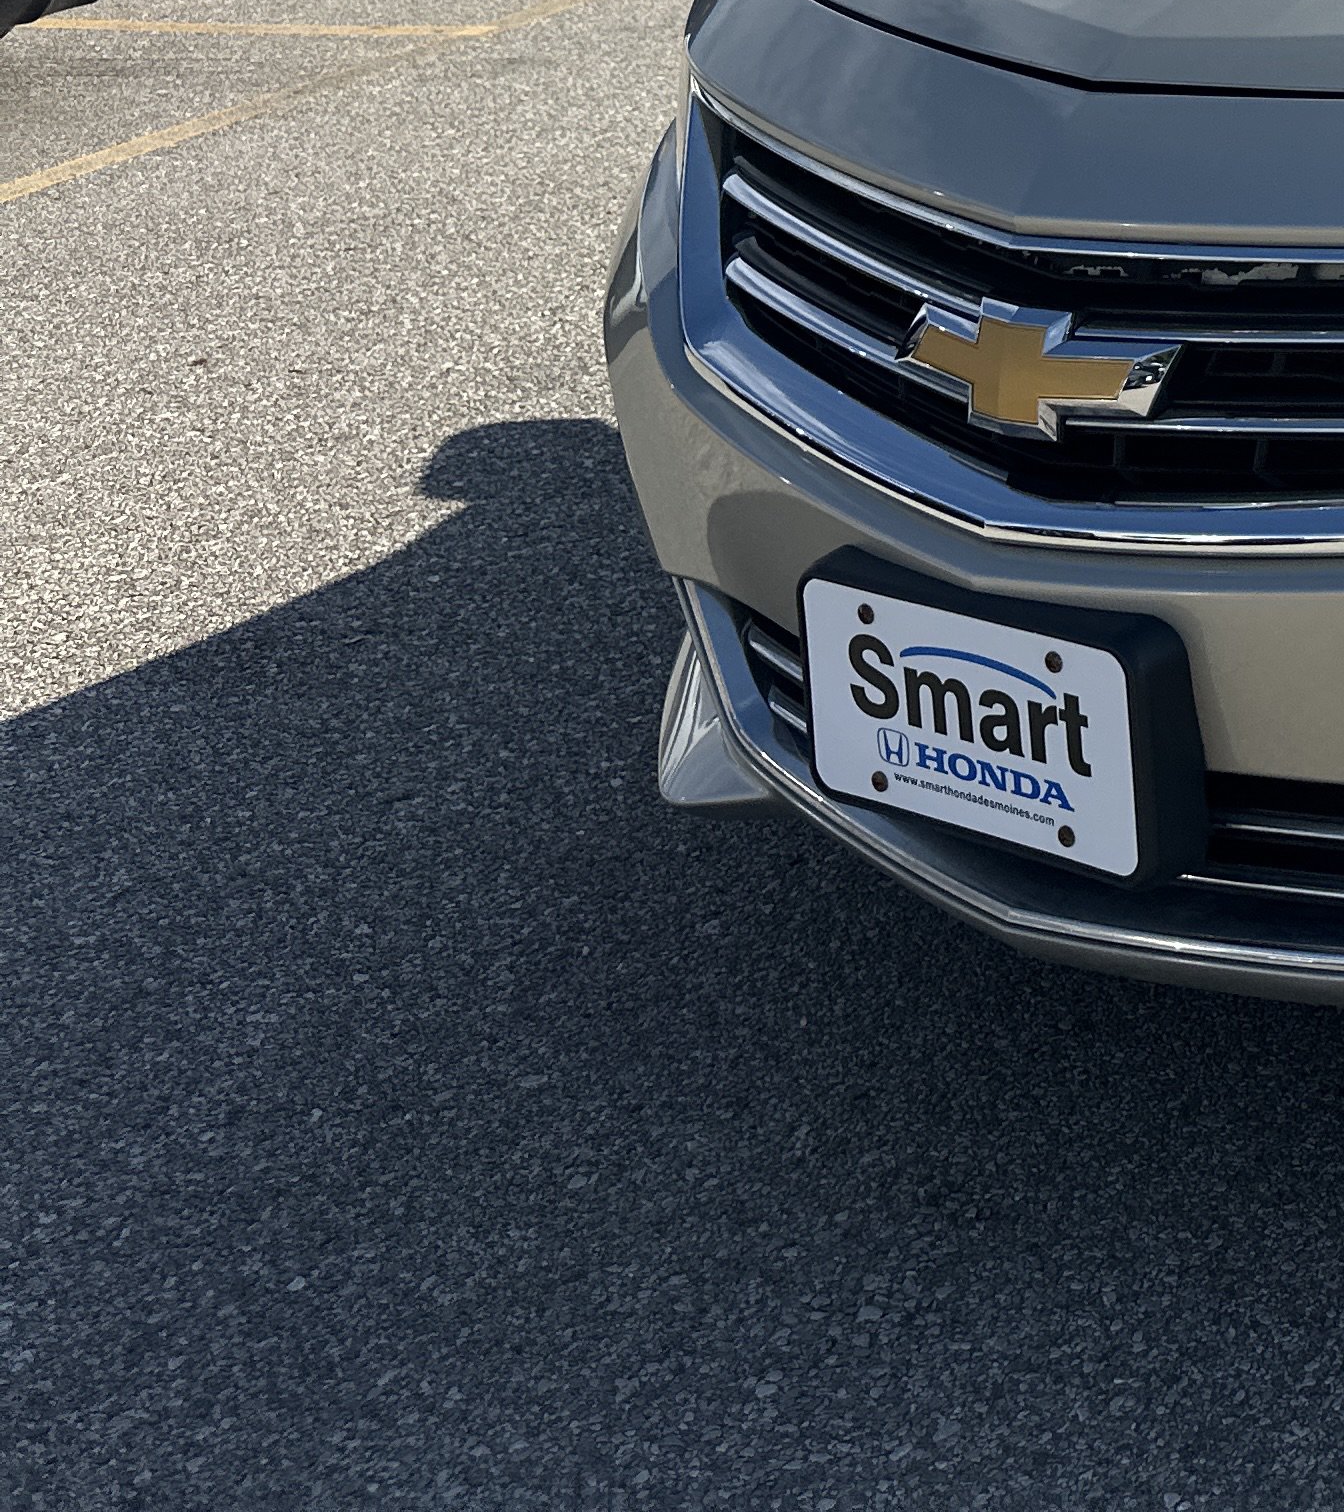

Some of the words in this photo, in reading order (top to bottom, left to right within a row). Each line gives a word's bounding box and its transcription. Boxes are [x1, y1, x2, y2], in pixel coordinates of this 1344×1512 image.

[847, 633, 1092, 778] Smart
[893, 771, 1056, 827] www.smarthondadesmoines.com
[913, 741, 1076, 812] HONDA
